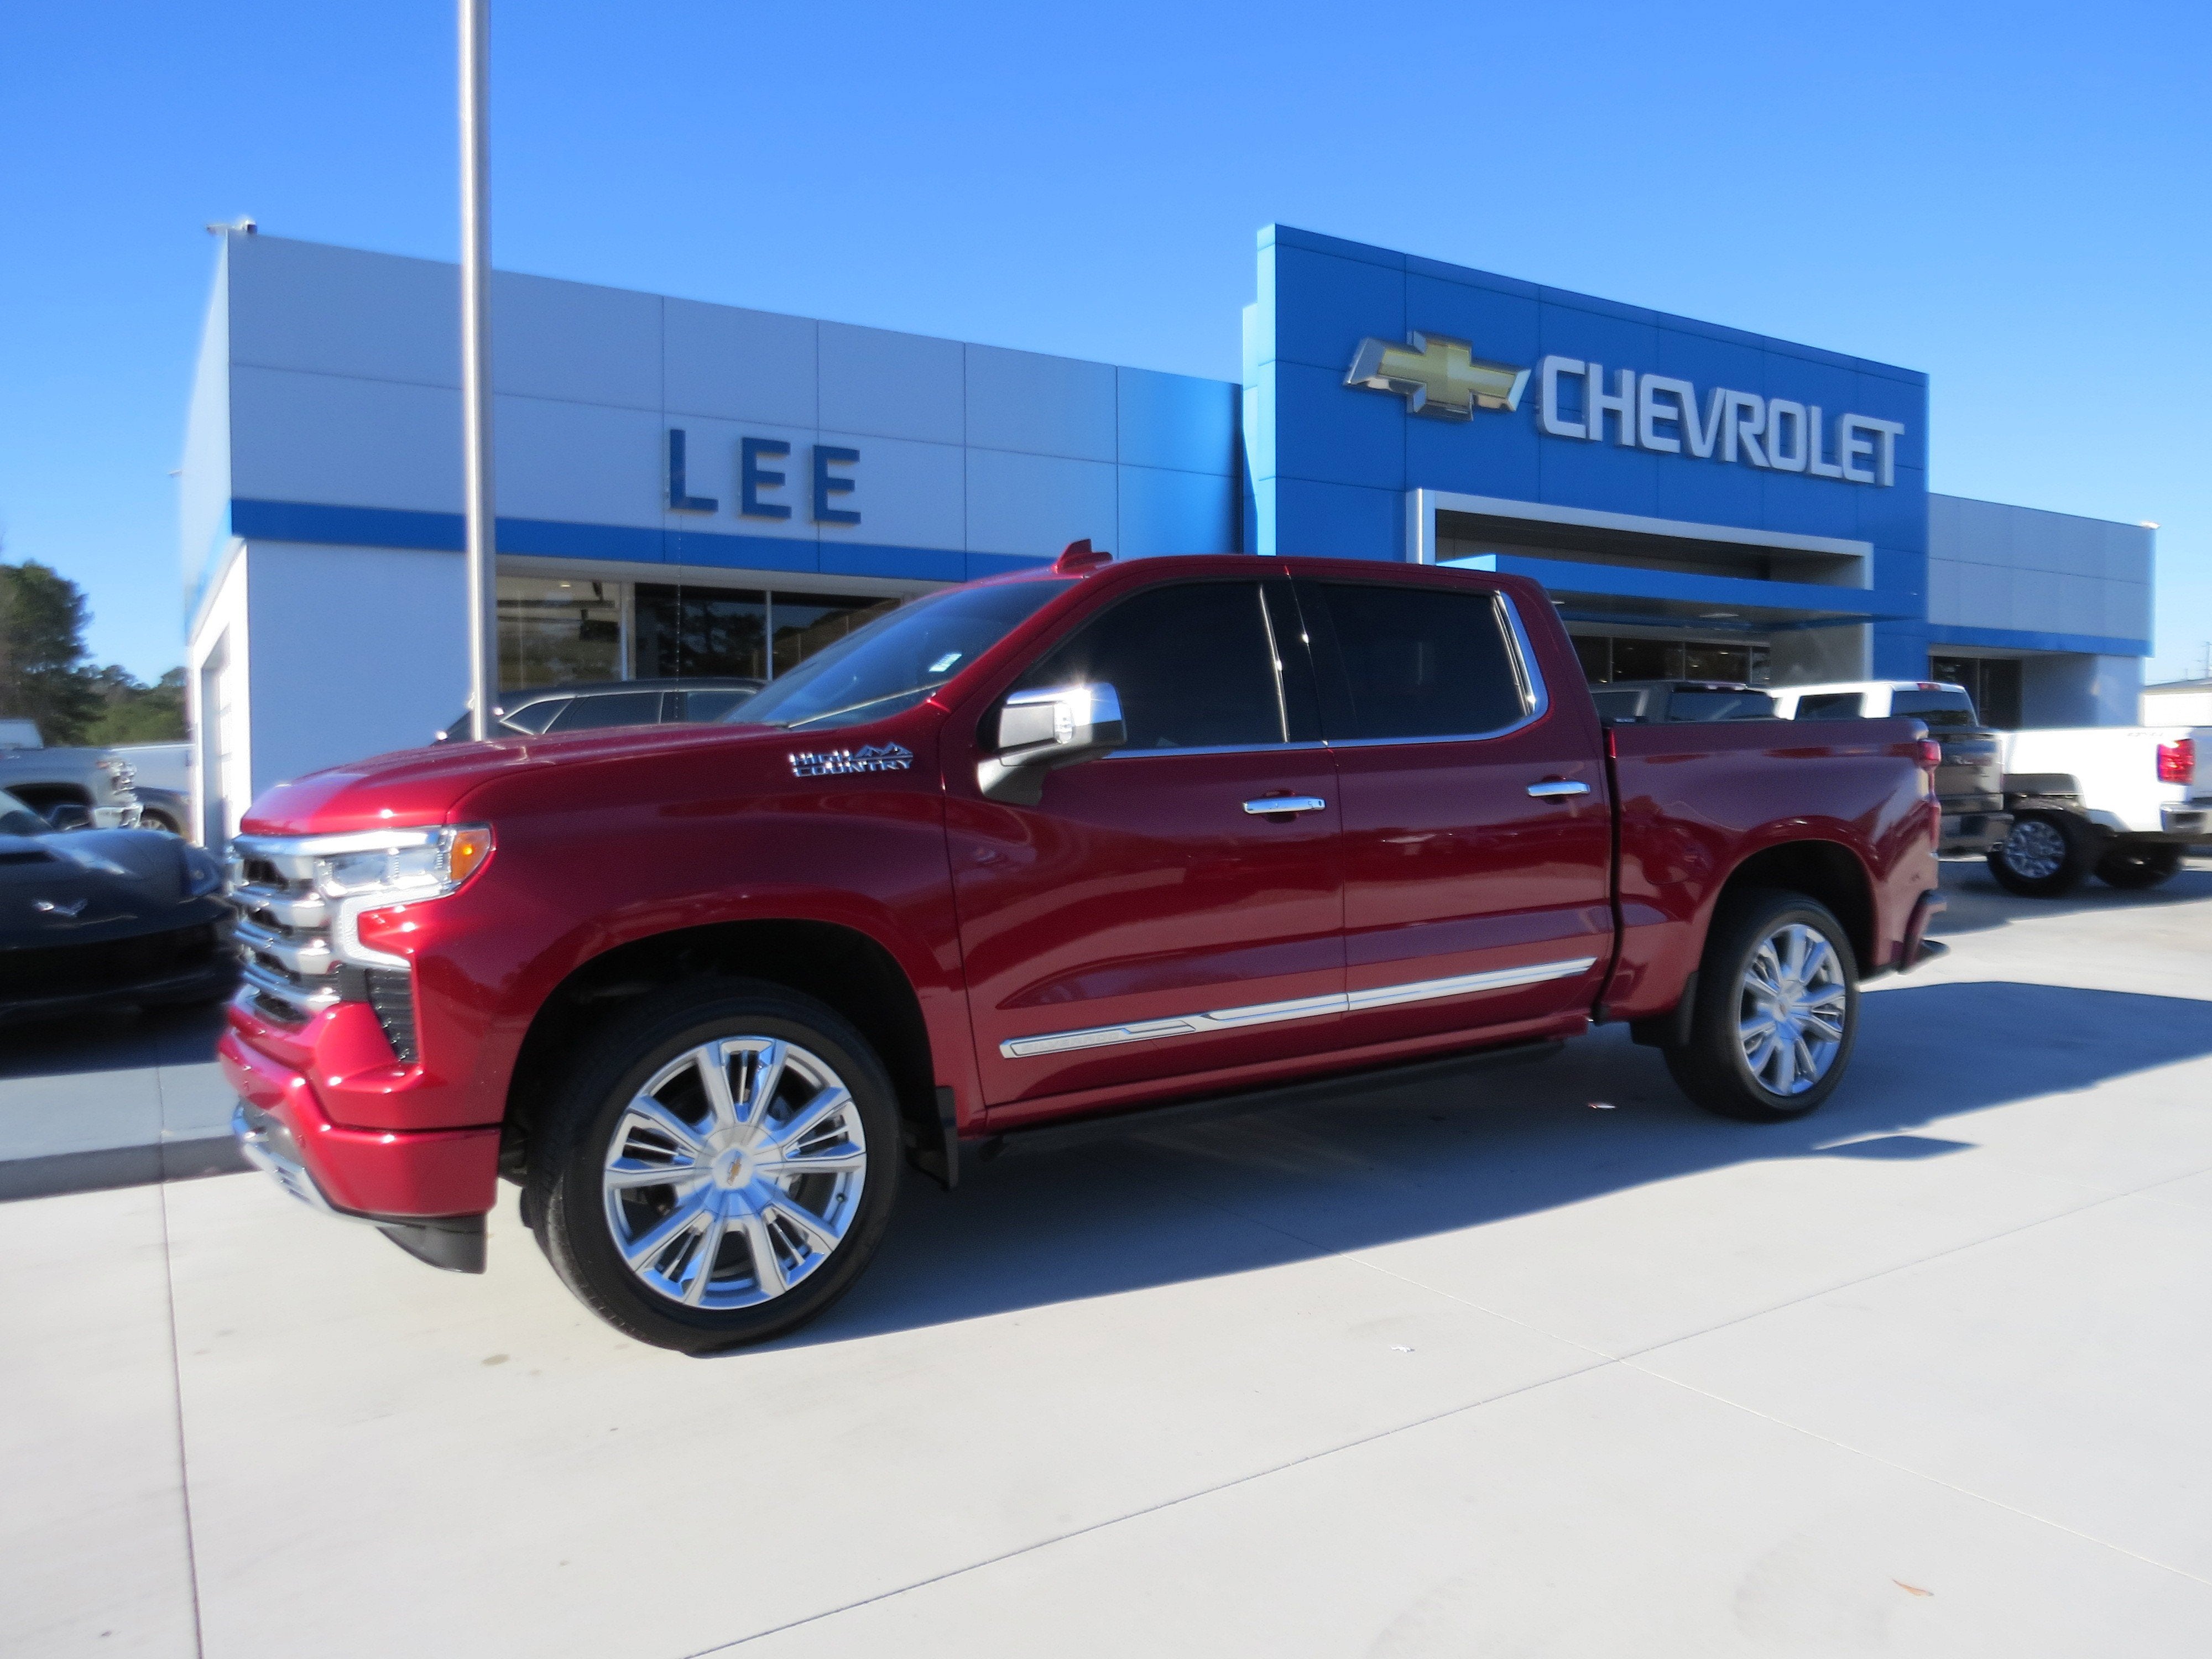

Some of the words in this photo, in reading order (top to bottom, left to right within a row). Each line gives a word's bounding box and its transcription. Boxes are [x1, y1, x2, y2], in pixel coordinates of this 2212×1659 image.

[1540, 354, 1905, 487] CHEVROLET
[669, 428, 862, 525] LEE
[789, 750, 853, 766] HIGH
[792, 759, 912, 777] COUNTRY
